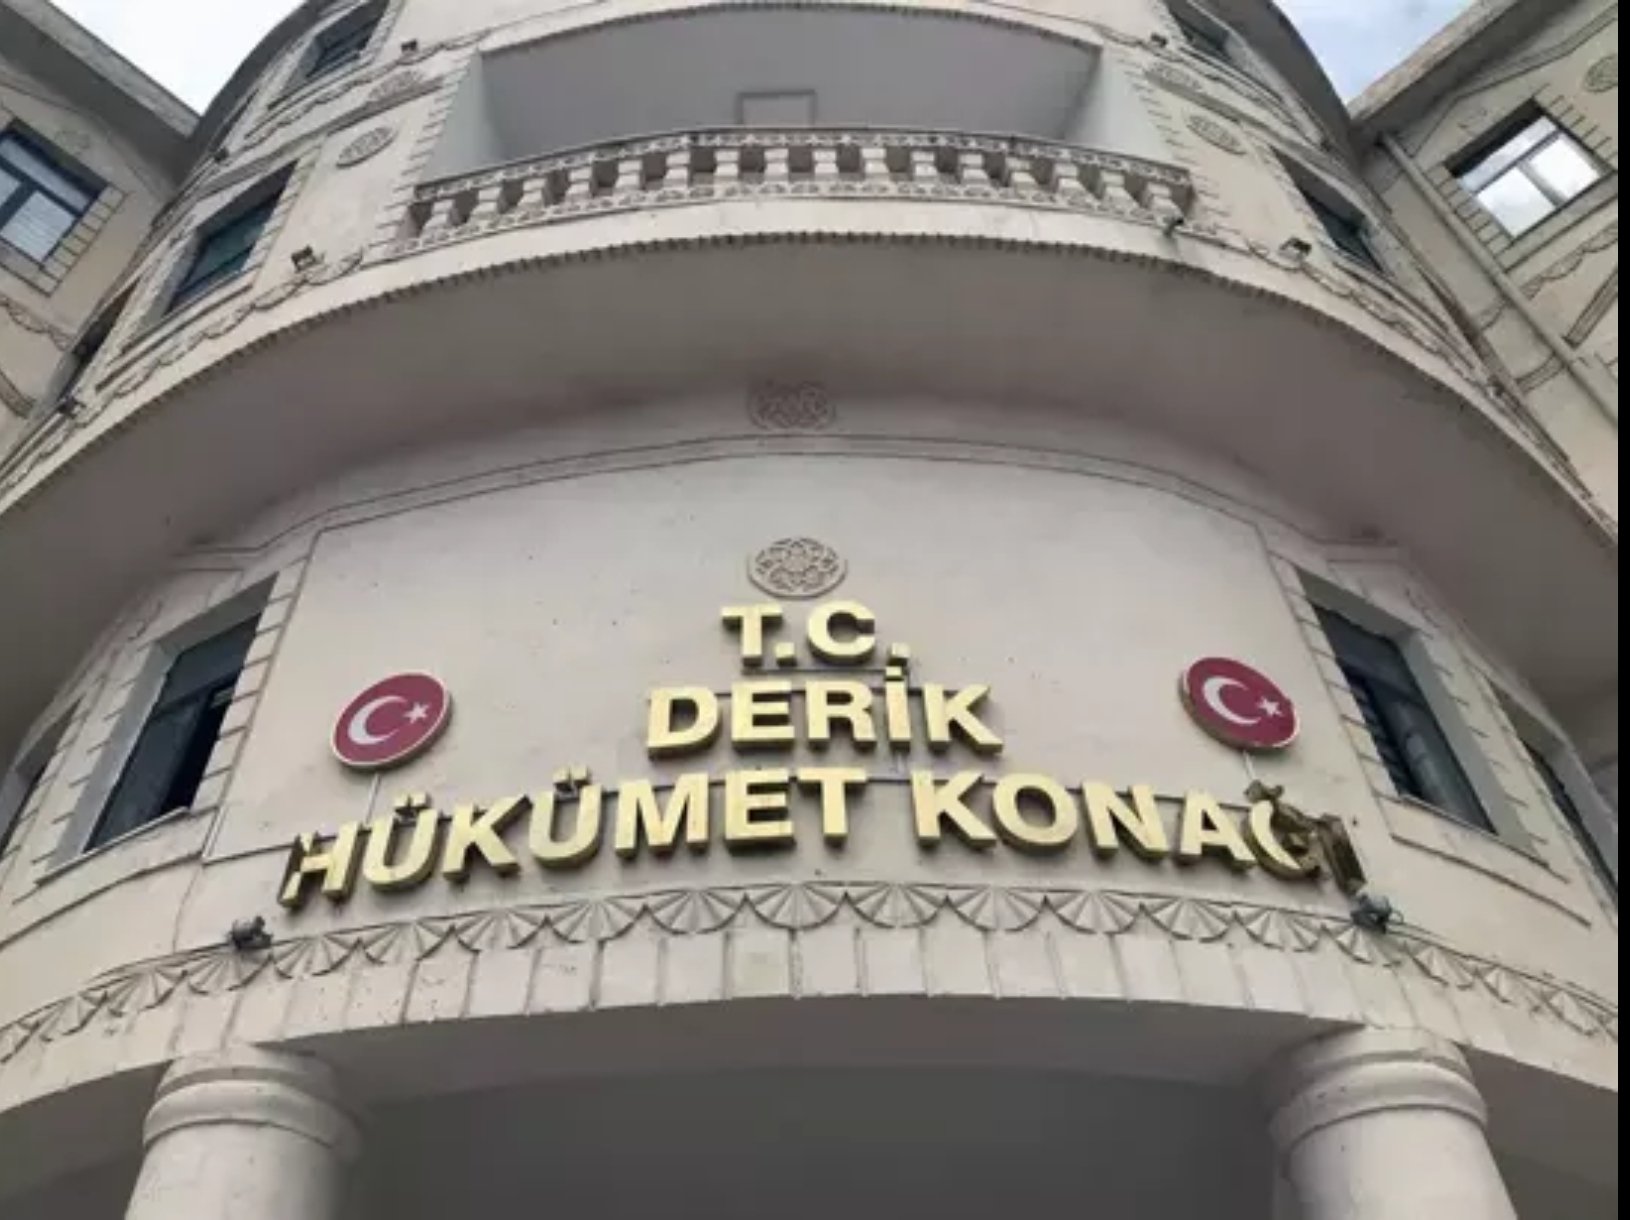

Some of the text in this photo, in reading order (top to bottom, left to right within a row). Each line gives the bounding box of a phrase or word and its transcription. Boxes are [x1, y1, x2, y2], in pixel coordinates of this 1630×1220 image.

[721, 601, 911, 667] T.C.
[647, 666, 1003, 757] DERİK
[278, 766, 866, 906] HÜKÜMET
